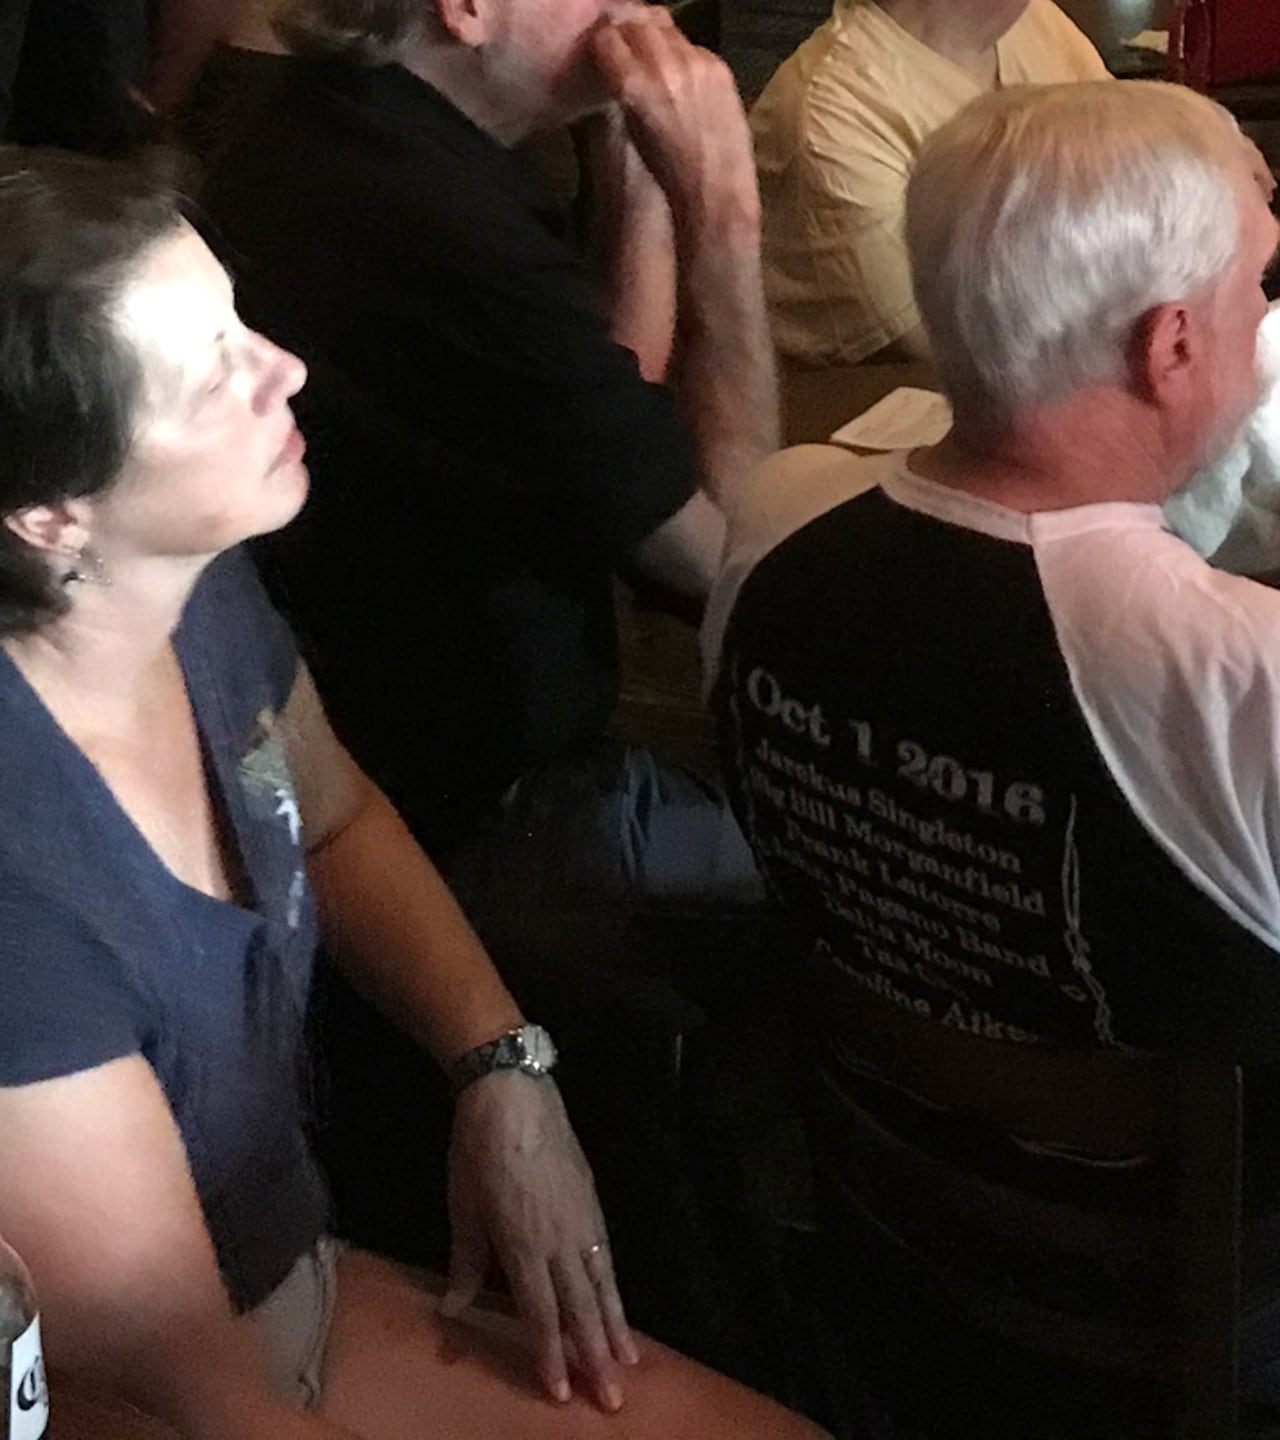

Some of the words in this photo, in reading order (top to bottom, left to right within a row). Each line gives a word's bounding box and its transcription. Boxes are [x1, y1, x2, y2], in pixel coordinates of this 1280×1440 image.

[748, 668, 831, 746] Oct
[848, 720, 874, 758] 1
[897, 740, 1045, 825] 2016
[869, 790, 1020, 872] Singleton
